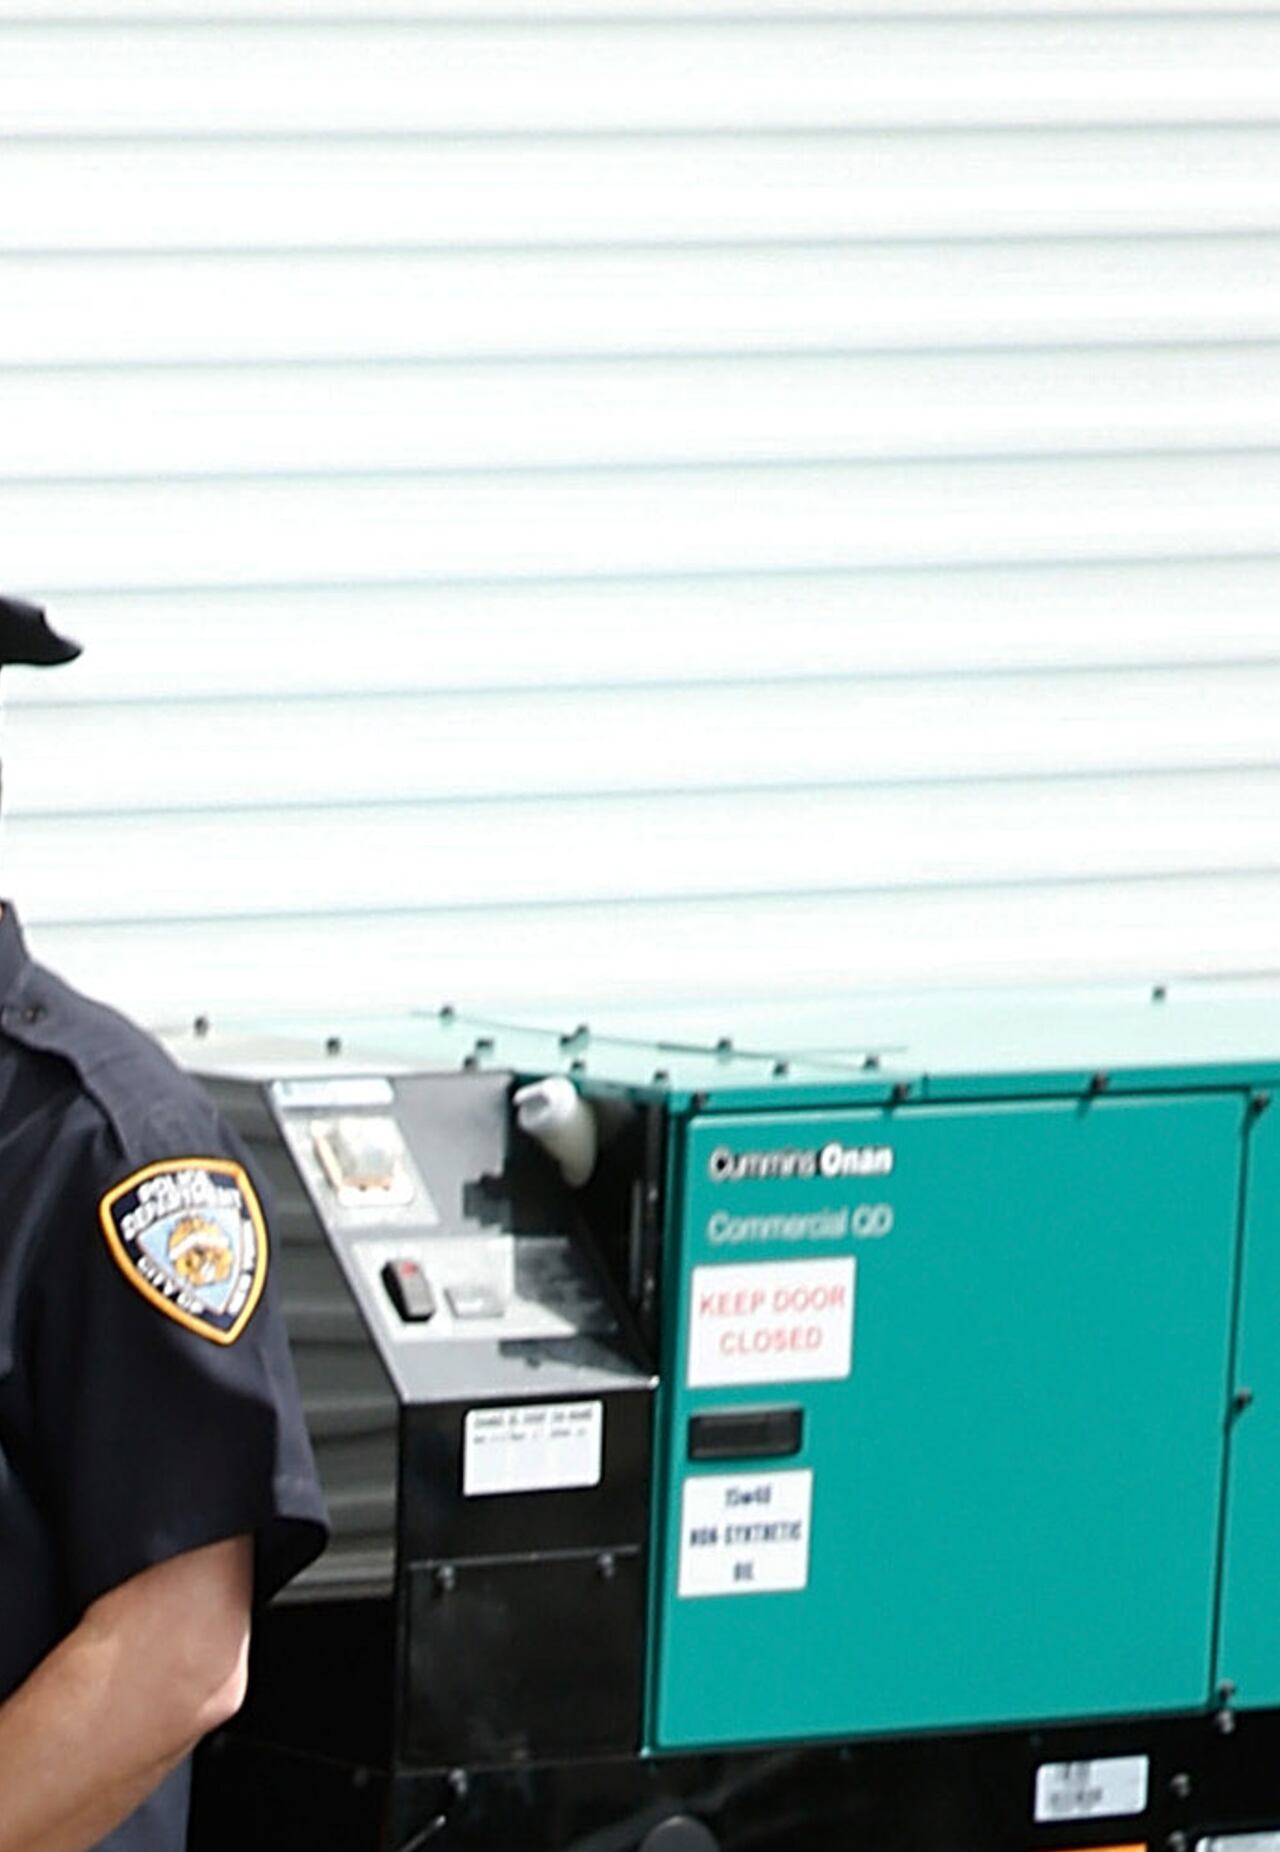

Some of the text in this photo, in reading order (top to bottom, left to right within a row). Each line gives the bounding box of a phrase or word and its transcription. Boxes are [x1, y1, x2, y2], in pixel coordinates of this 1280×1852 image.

[820, 1142, 893, 1177] Onan
[699, 1284, 846, 1318] KEEP DOOR
[719, 1326, 824, 1356] CLOSED
